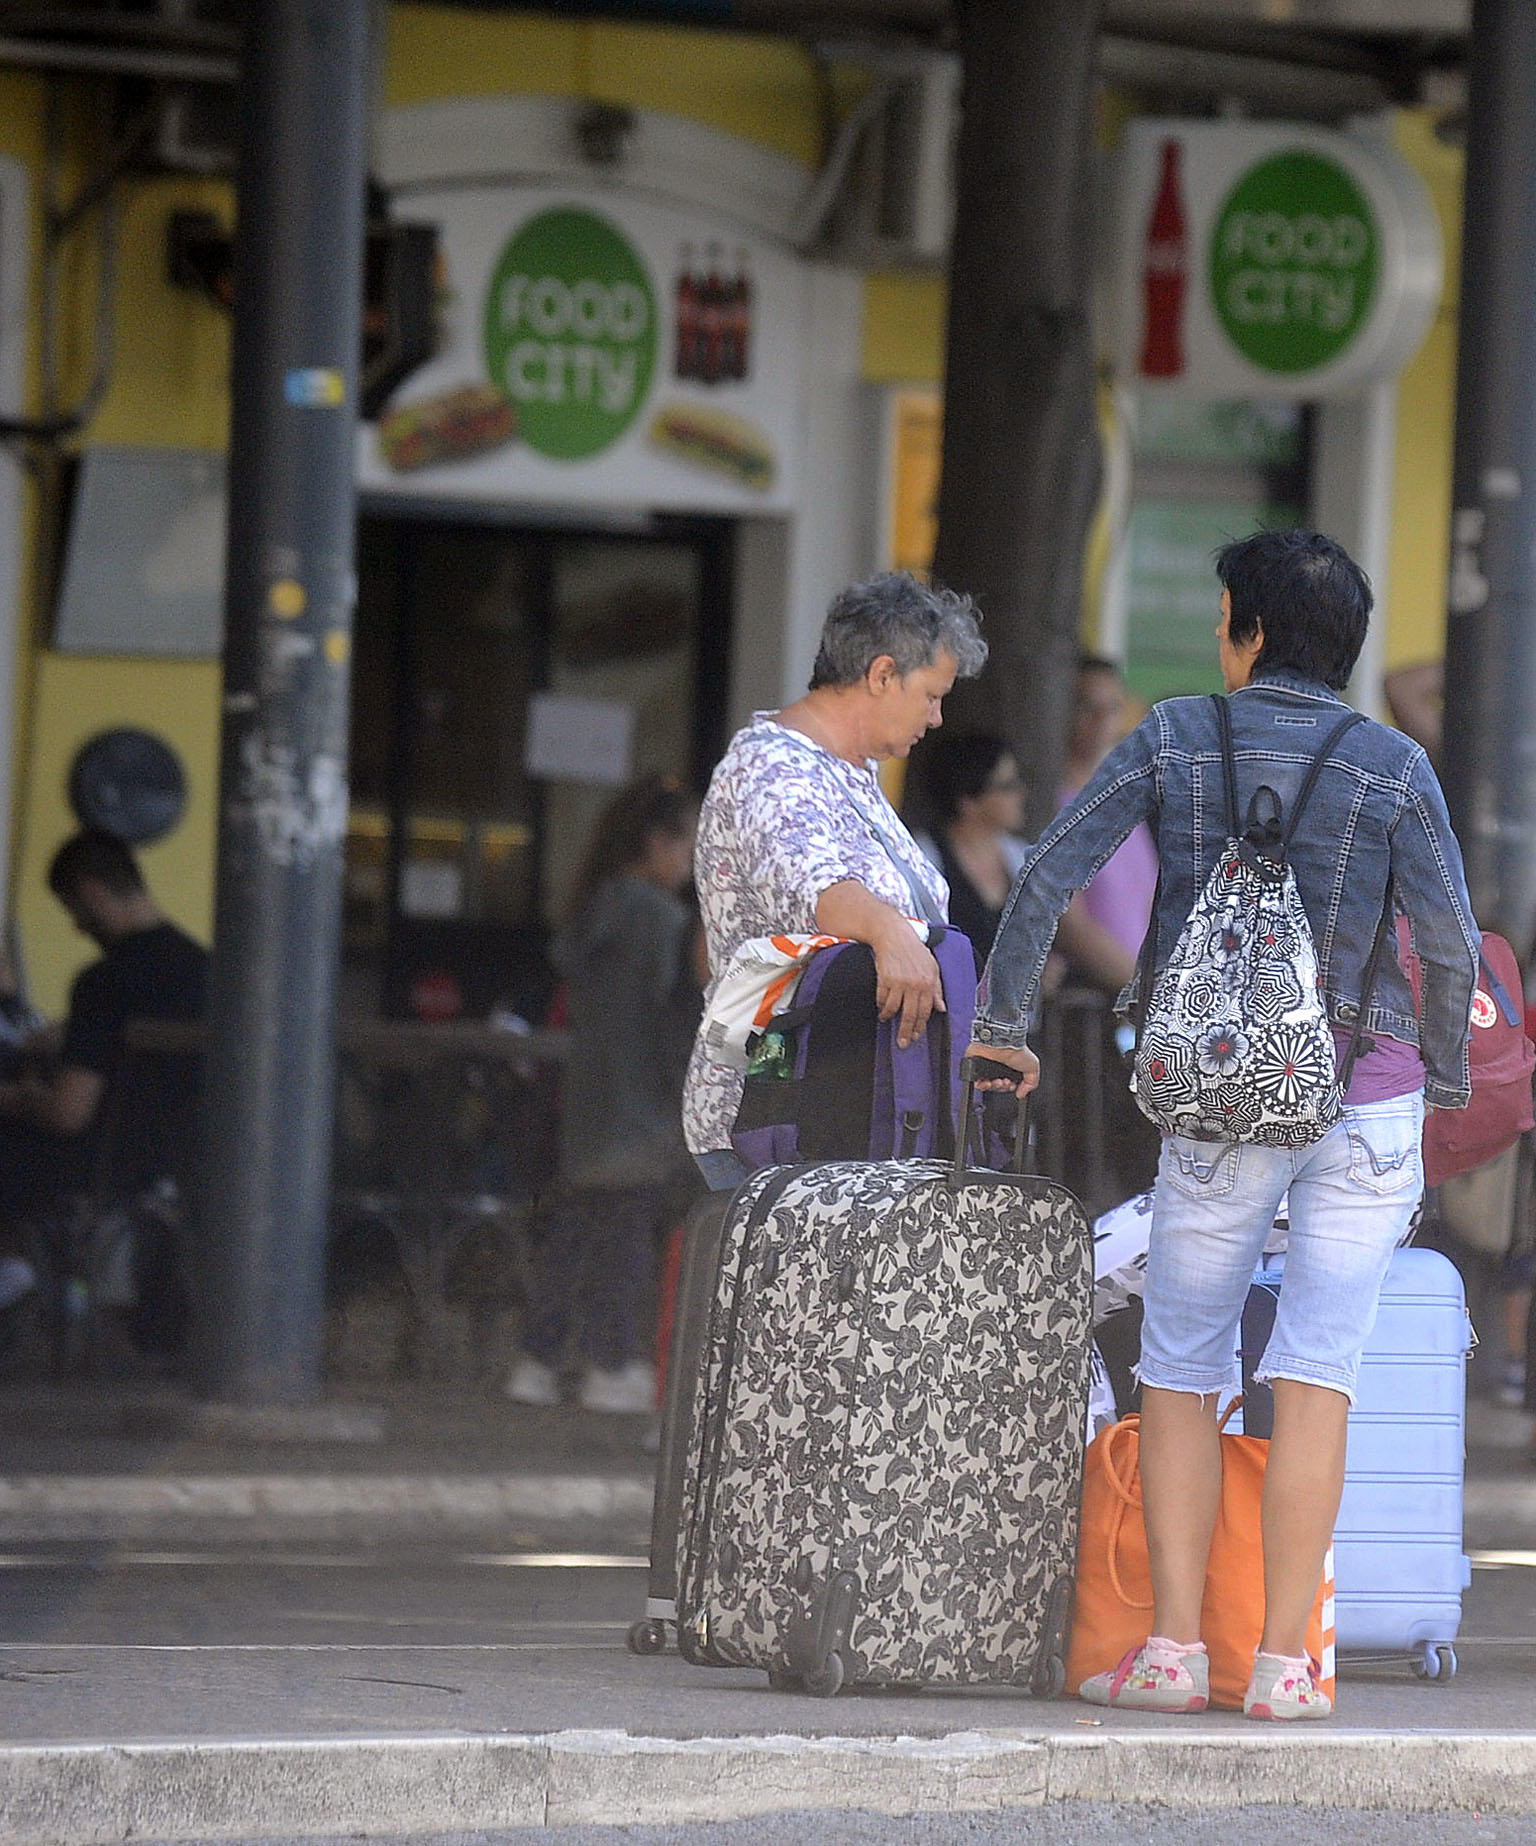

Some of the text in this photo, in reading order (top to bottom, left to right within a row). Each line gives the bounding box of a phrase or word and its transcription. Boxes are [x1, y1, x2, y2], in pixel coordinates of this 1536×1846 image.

[1225, 211, 1369, 268] FOOD
[502, 275, 650, 341] FOOD
[1227, 268, 1356, 332] CITY
[505, 341, 637, 414] CITY
